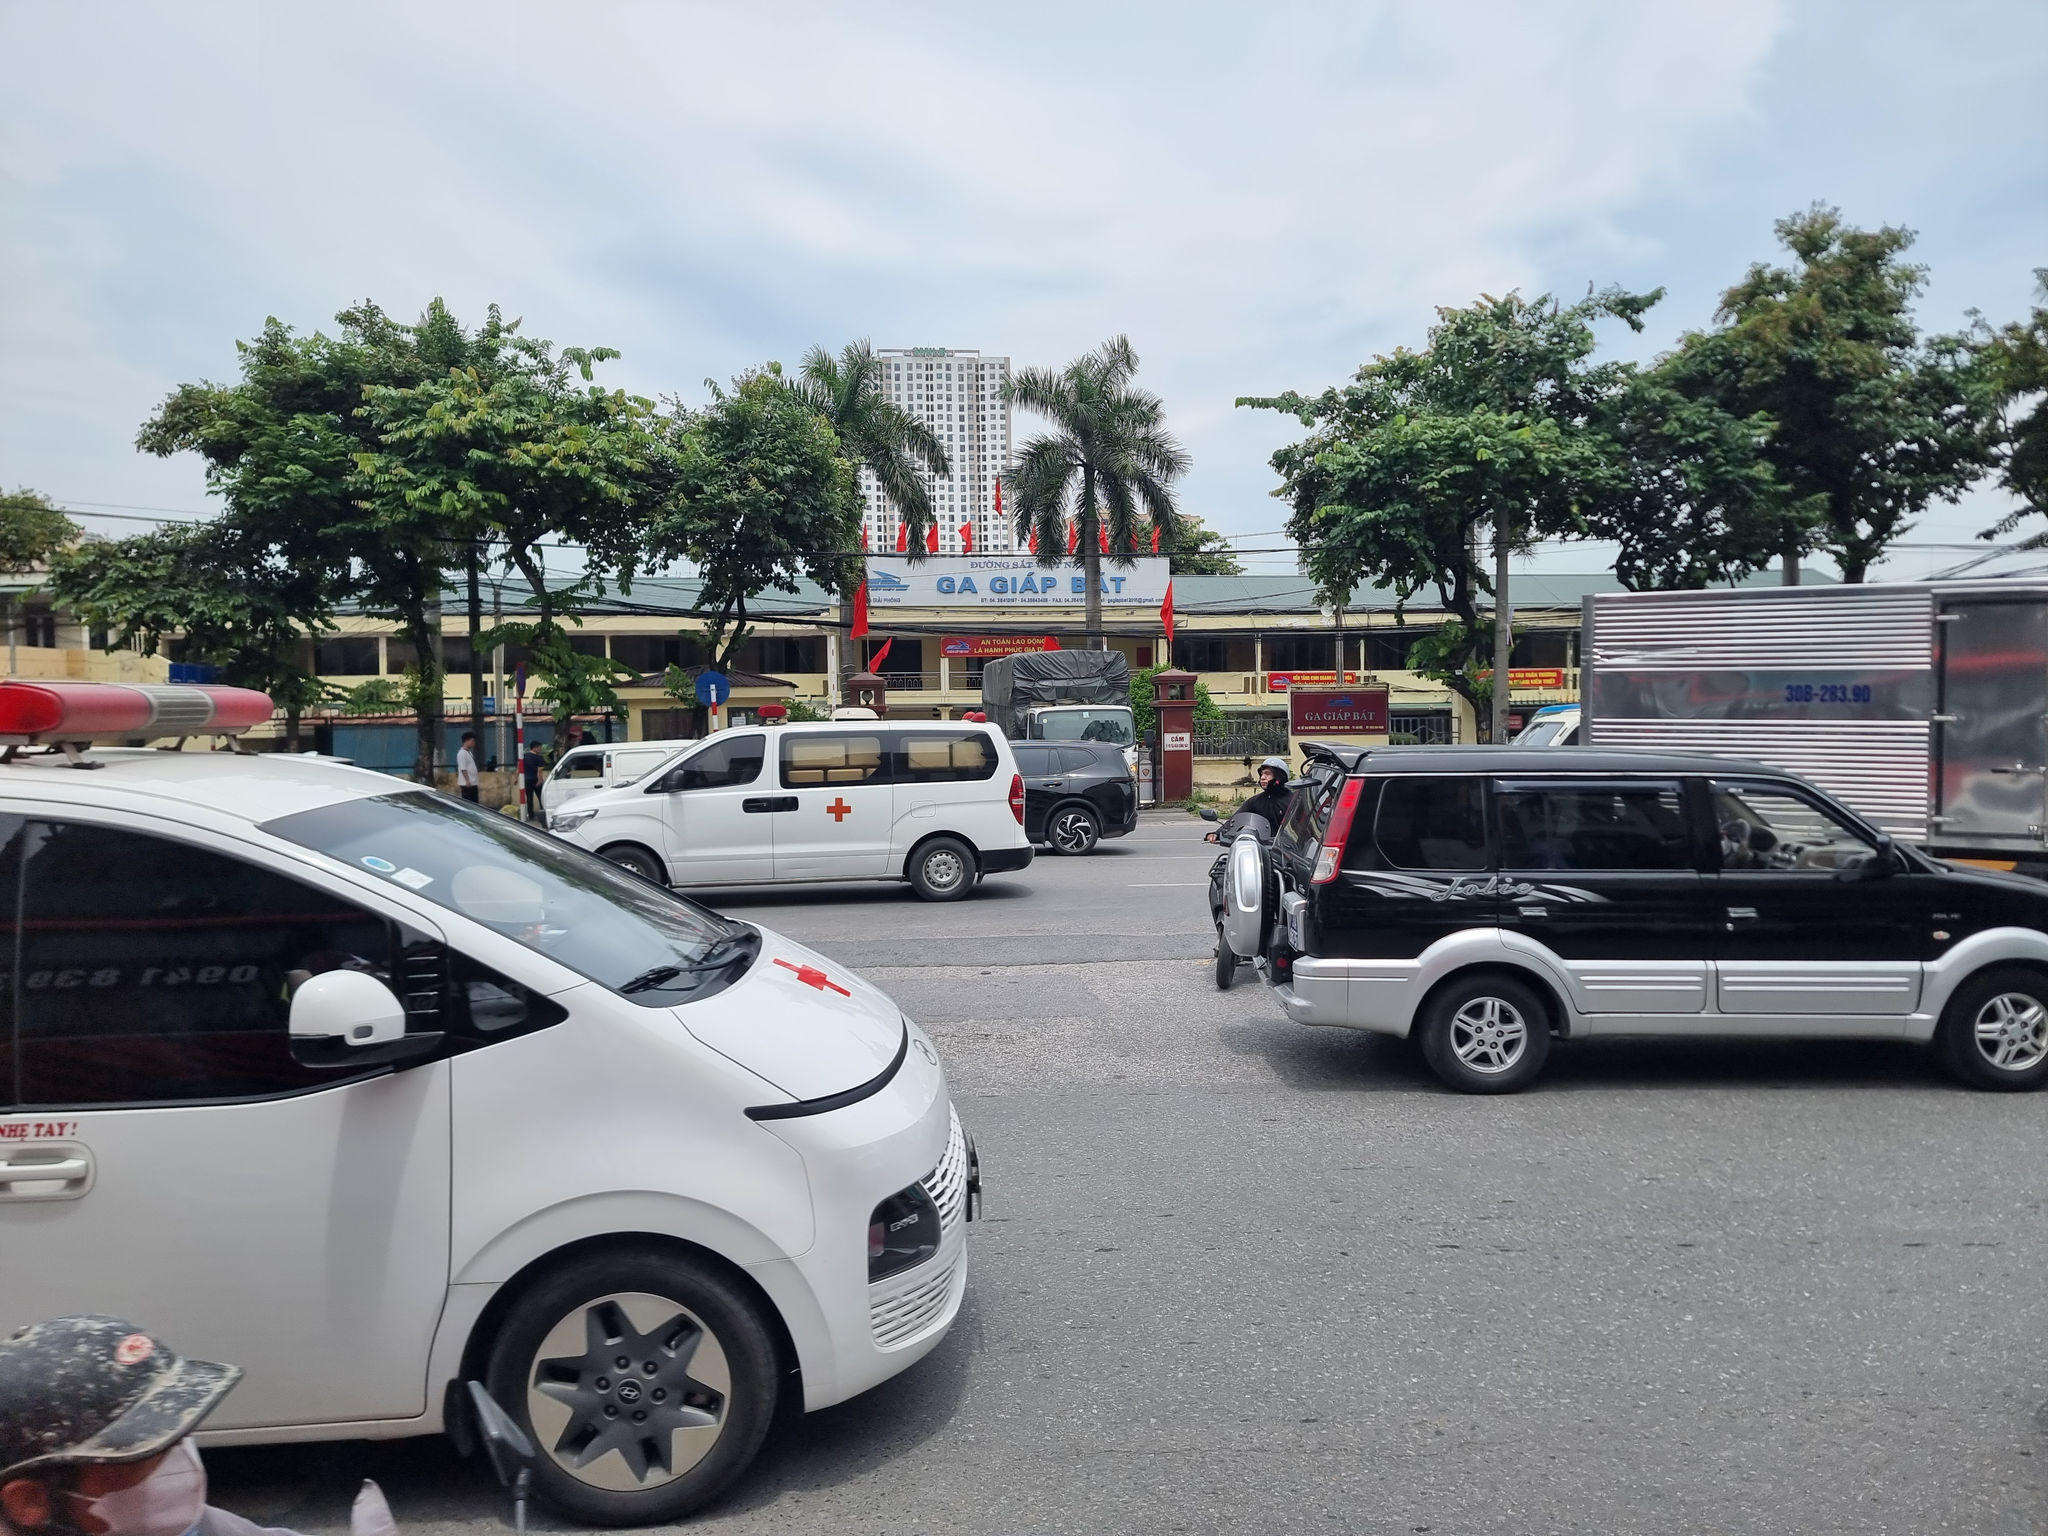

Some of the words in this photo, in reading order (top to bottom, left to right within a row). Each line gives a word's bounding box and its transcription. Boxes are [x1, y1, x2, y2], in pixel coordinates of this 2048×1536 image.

[936, 576, 978, 594] GA
[989, 572, 1057, 594] GIÁP
[1304, 711, 1321, 721] GA
[1323, 708, 1351, 721] GIÁP
[1430, 876, 1535, 901] Jolie
